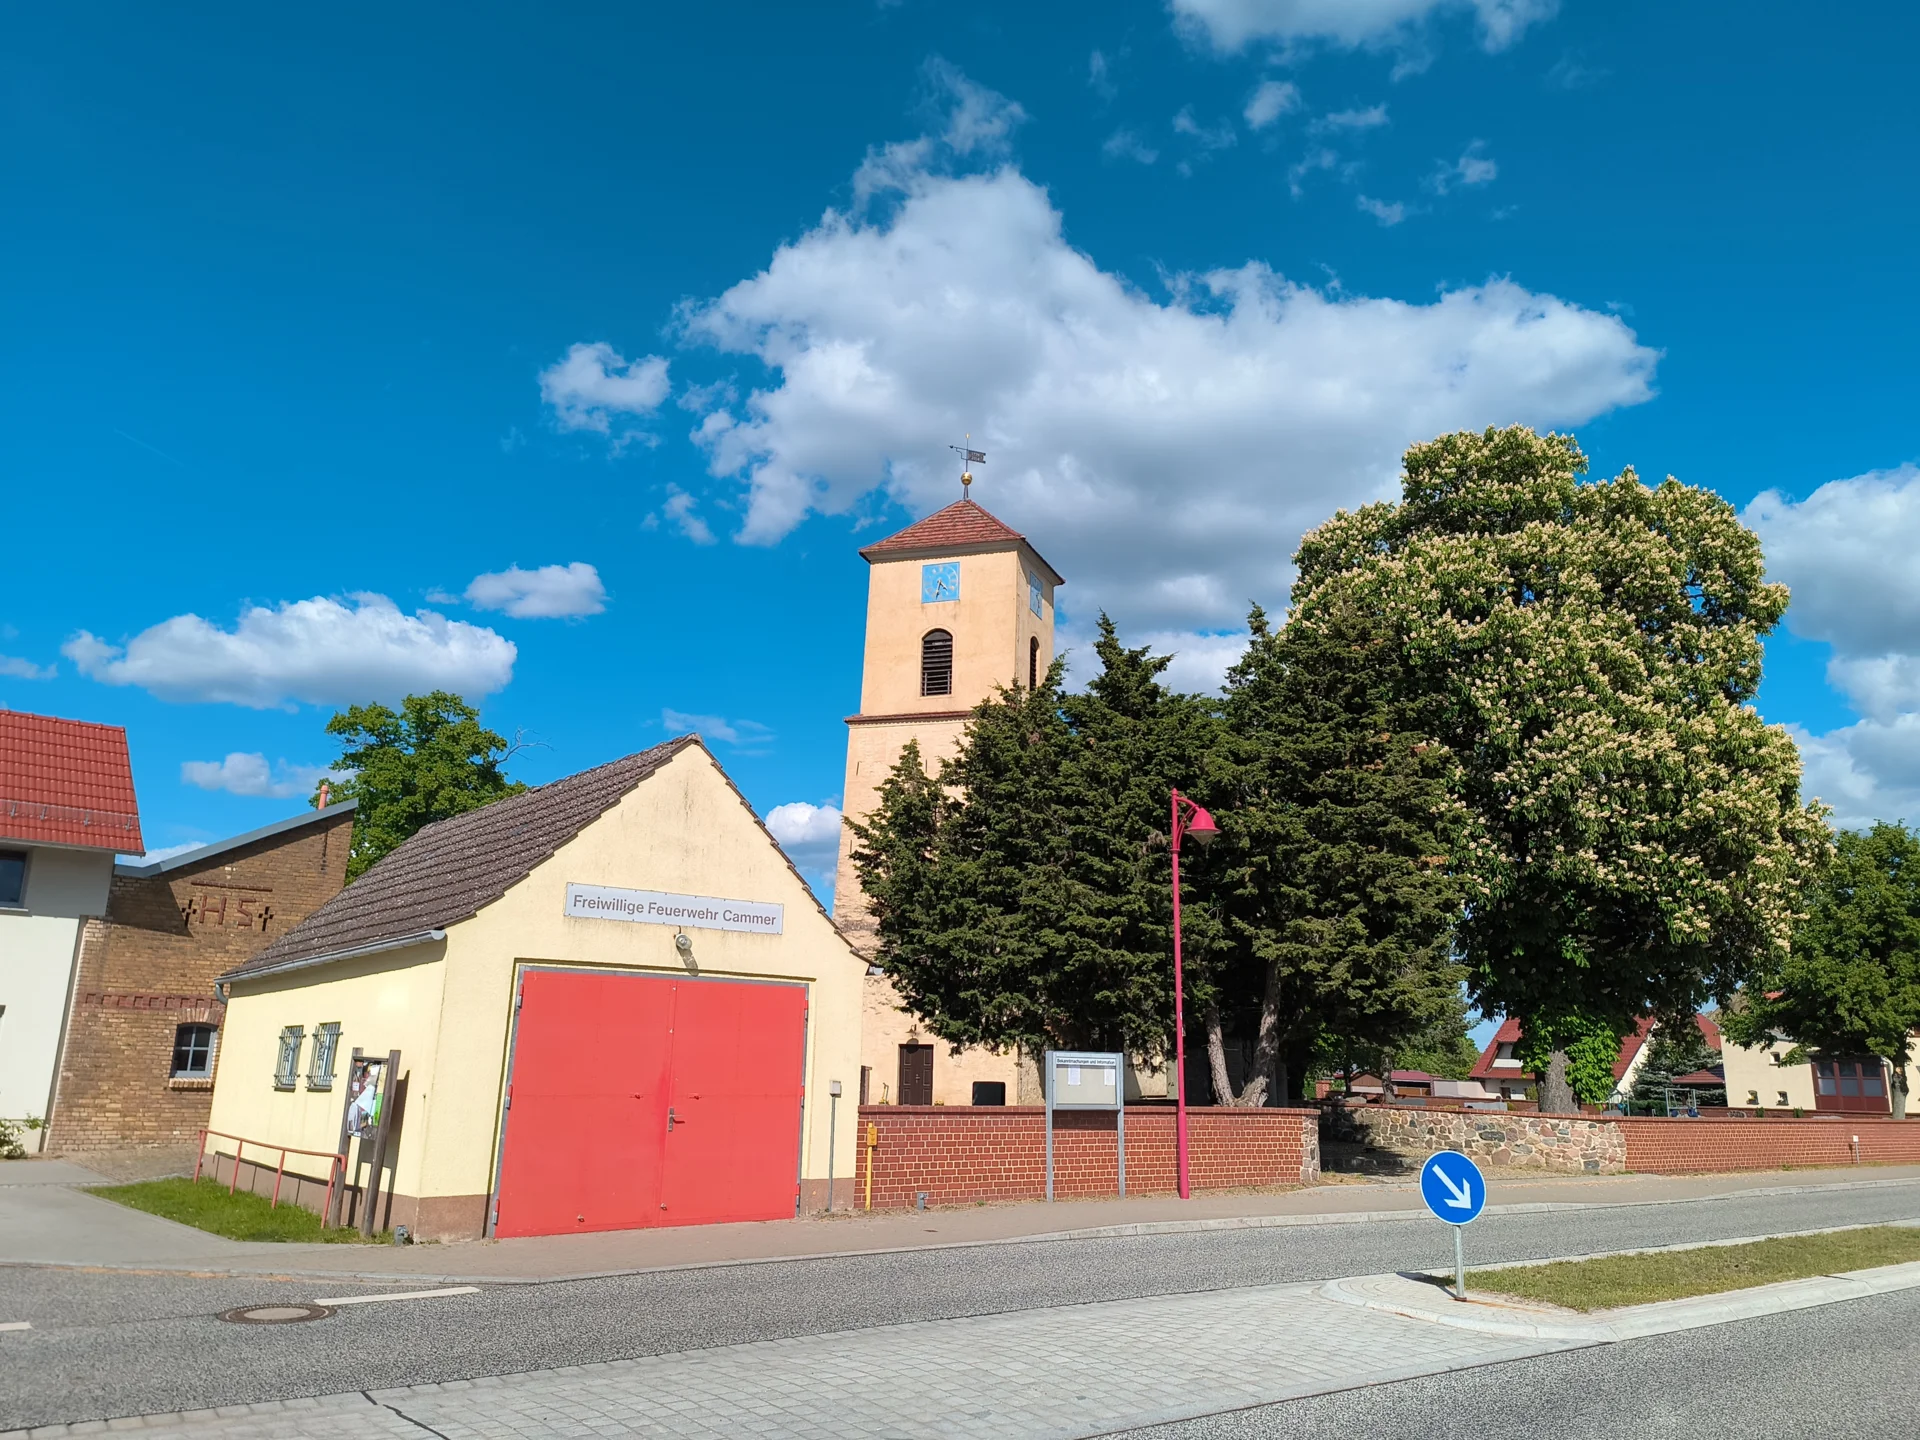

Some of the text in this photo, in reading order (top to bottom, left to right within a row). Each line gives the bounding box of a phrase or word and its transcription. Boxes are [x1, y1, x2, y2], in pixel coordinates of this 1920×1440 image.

[573, 894, 776, 926] Freiwillige Feuerwehr Cammer
